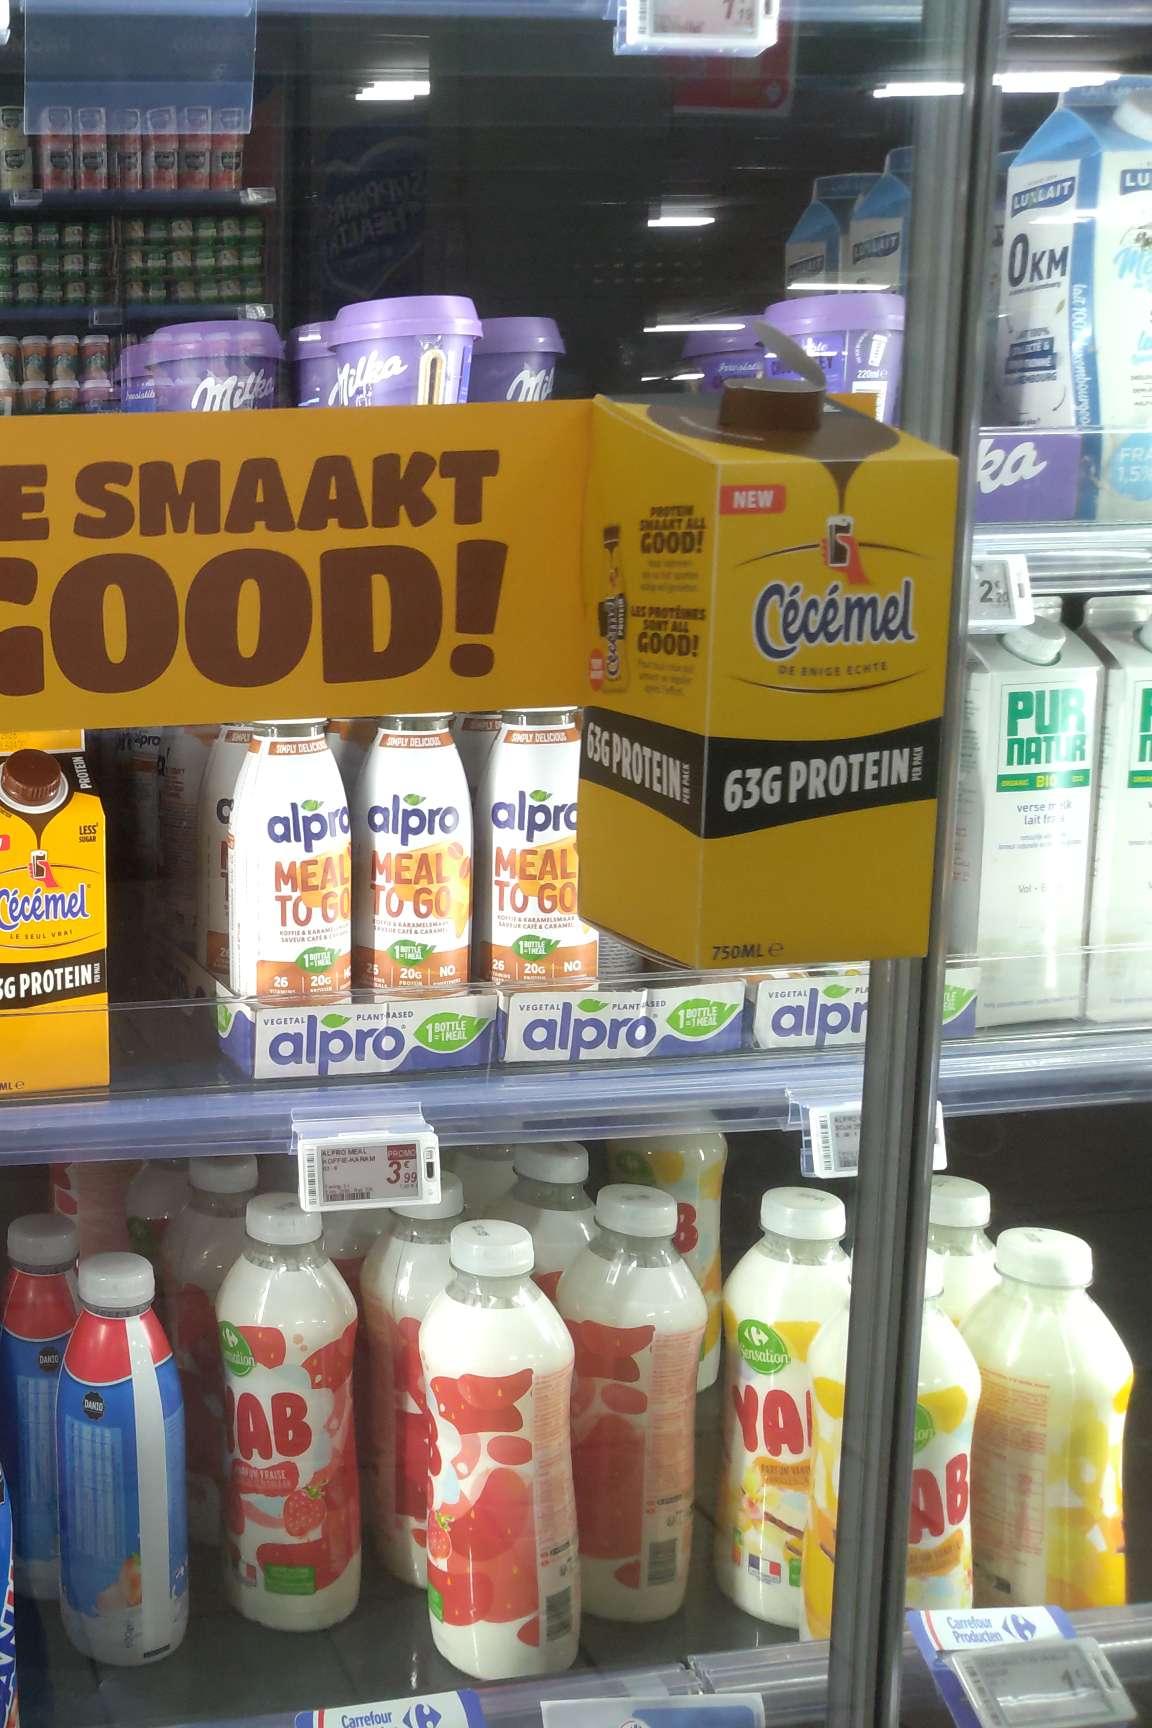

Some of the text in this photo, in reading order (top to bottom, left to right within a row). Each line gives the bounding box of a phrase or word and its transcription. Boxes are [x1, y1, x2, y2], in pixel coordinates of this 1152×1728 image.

[1013, 180, 1073, 208] LUXLAIT
[332, 349, 408, 405] Milka
[73, 449, 500, 540] SMAAKT
[732, 489, 775, 510] NEW
[686, 517, 706, 531] ALL
[640, 530, 705, 554] GOOD!
[979, 580, 993, 603] 2
[671, 621, 690, 634] ALL
[754, 576, 917, 662] Cécémel
[637, 631, 700, 658] GOOD!
[778, 665, 795, 676] DE
[800, 667, 841, 676] ENIGE
[1006, 687, 1086, 737] PUR
[276, 742, 297, 754] SIMPLY
[386, 734, 441, 747] SIMPLY DELICIOUS
[510, 731, 567, 743] SIMPLY DELICIOUS
[586, 721, 682, 802] 63G PROTEIN
[911, 745, 924, 768] PACK
[72, 755, 92, 790] PROTEIN
[723, 747, 912, 814] 63G PROTEIN
[491, 790, 578, 843] alpro
[1016, 802, 1045, 813] verse
[367, 794, 460, 846] alpro
[1024, 814, 1040, 825] lait
[274, 854, 351, 893] MEAL
[370, 847, 445, 885] MEAL
[494, 844, 577, 881] MEAL
[371, 884, 452, 919] TO GO
[495, 882, 578, 915] TO GO
[275, 895, 313, 927] TO
[24, 932, 48, 940] SEUL
[51, 930, 74, 938] VRAI
[711, 942, 764, 961] 750ML
[399, 965, 456, 979] 20G NO
[491, 959, 582, 974] 26 20G NO
[19, 963, 93, 998] PROTEIN
[273, 974, 332, 987] 26 20G
[767, 990, 808, 999] VEGETAL
[518, 1003, 561, 1012] VEGETAL
[686, 1006, 718, 1018] BOTTLE
[263, 1016, 306, 1026] VEGETAL
[434, 1020, 467, 1032] BOTTLE
[521, 1001, 658, 1062] alpro
[268, 1014, 405, 1077] alpro
[347, 1147, 367, 1156] MEAL
[386, 1160, 402, 1184] 3
[403, 1172, 418, 1184] 99
[38, 1353, 59, 1366] DANIO
[83, 1399, 104, 1412] DANIO
[732, 1384, 812, 1457] YA
[946, 1616, 993, 1630] Carrefour
[952, 1630, 1003, 1644] Producten
[340, 1710, 392, 1728] Carrefour
